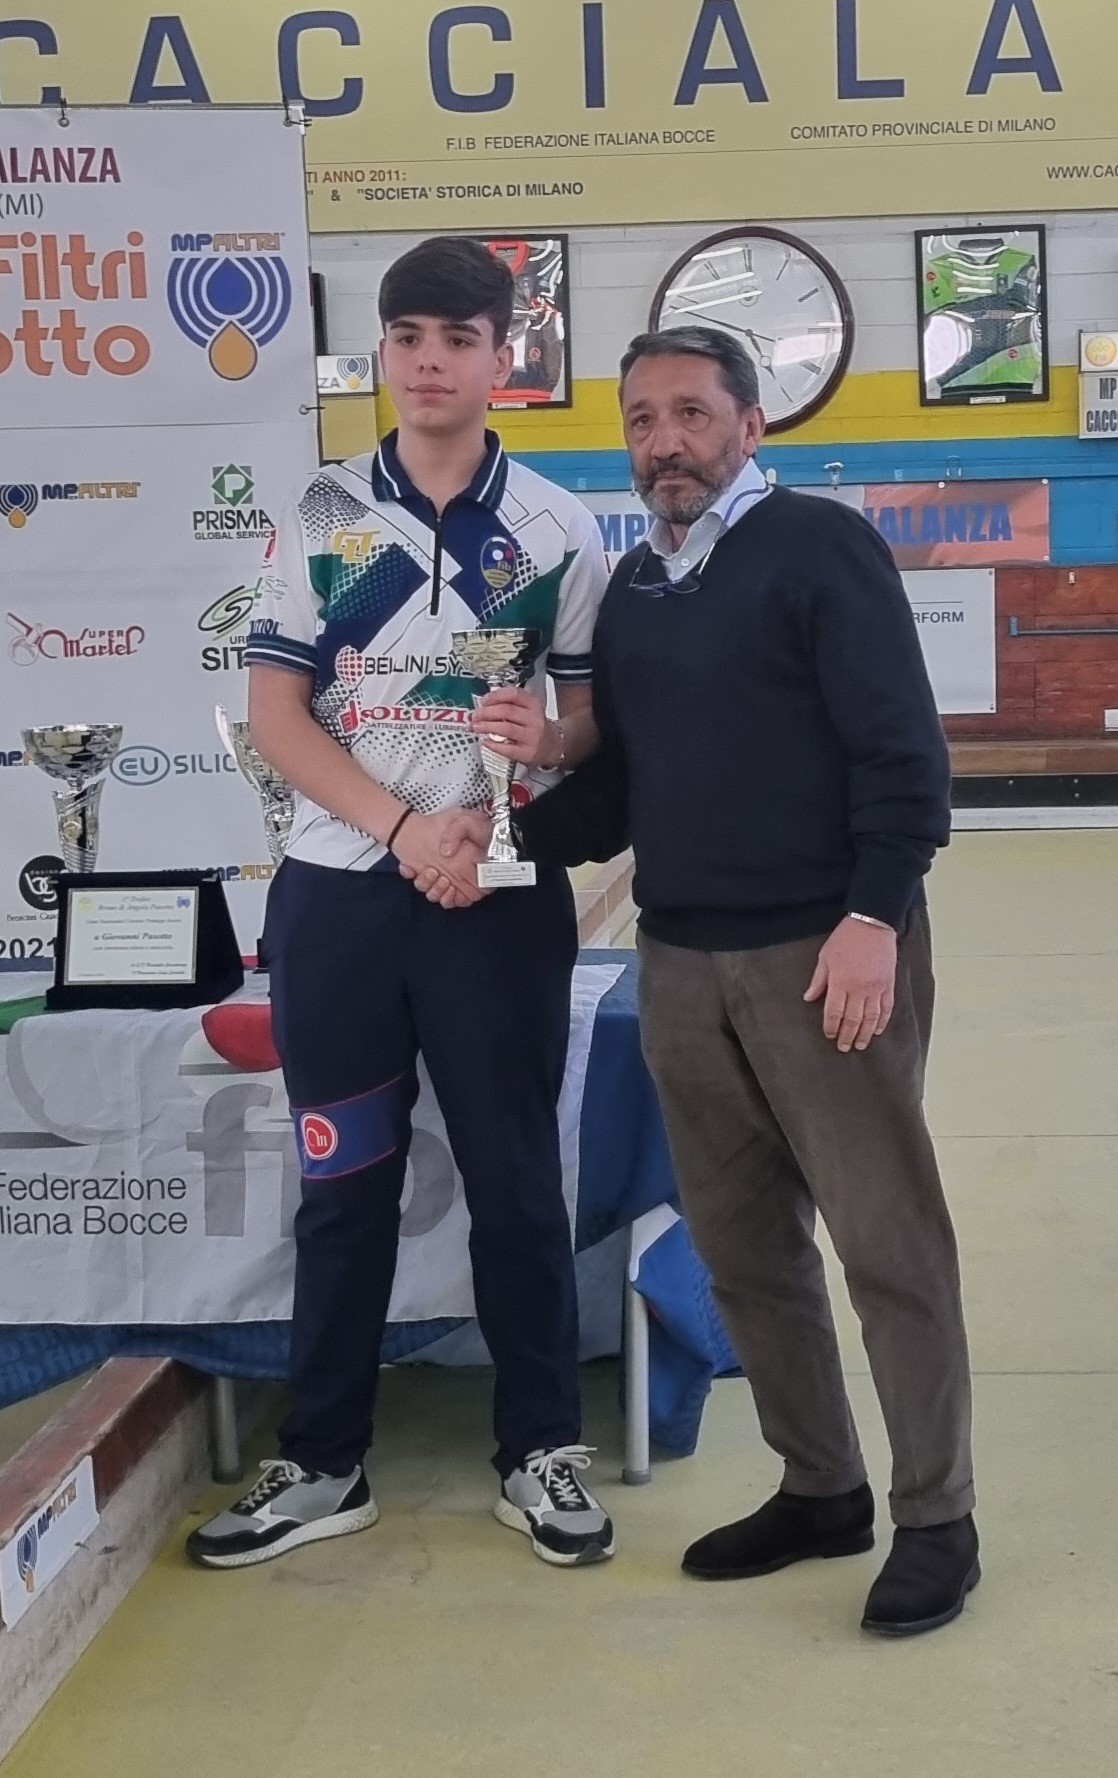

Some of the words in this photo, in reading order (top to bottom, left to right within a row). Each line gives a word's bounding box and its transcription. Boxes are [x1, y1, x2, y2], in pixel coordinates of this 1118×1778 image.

[790, 124, 868, 139] COMITATO
[872, 120, 973, 136] PROVINCIALE
[978, 120, 993, 132] DI
[997, 117, 1056, 132] MILANO
[446, 138, 477, 150] F.I.B
[484, 133, 590, 149] FEDERAZIONE
[594, 132, 659, 146] ITALIANA
[663, 129, 715, 144] BOCCE
[322, 169, 365, 183] ANNO
[369, 169, 407, 182] 2011:
[331, 189, 341, 201] &
[436, 184, 502, 199] STORICA
[506, 184, 521, 196] DI
[525, 182, 584, 196] MILANO
[0, 309, 151, 376] tto
[1099, 378, 1117, 400] MP
[193, 509, 275, 531] PRISMA
[195, 532, 233, 540] GLOBAL
[84, 1205, 188, 1235] Bocce
